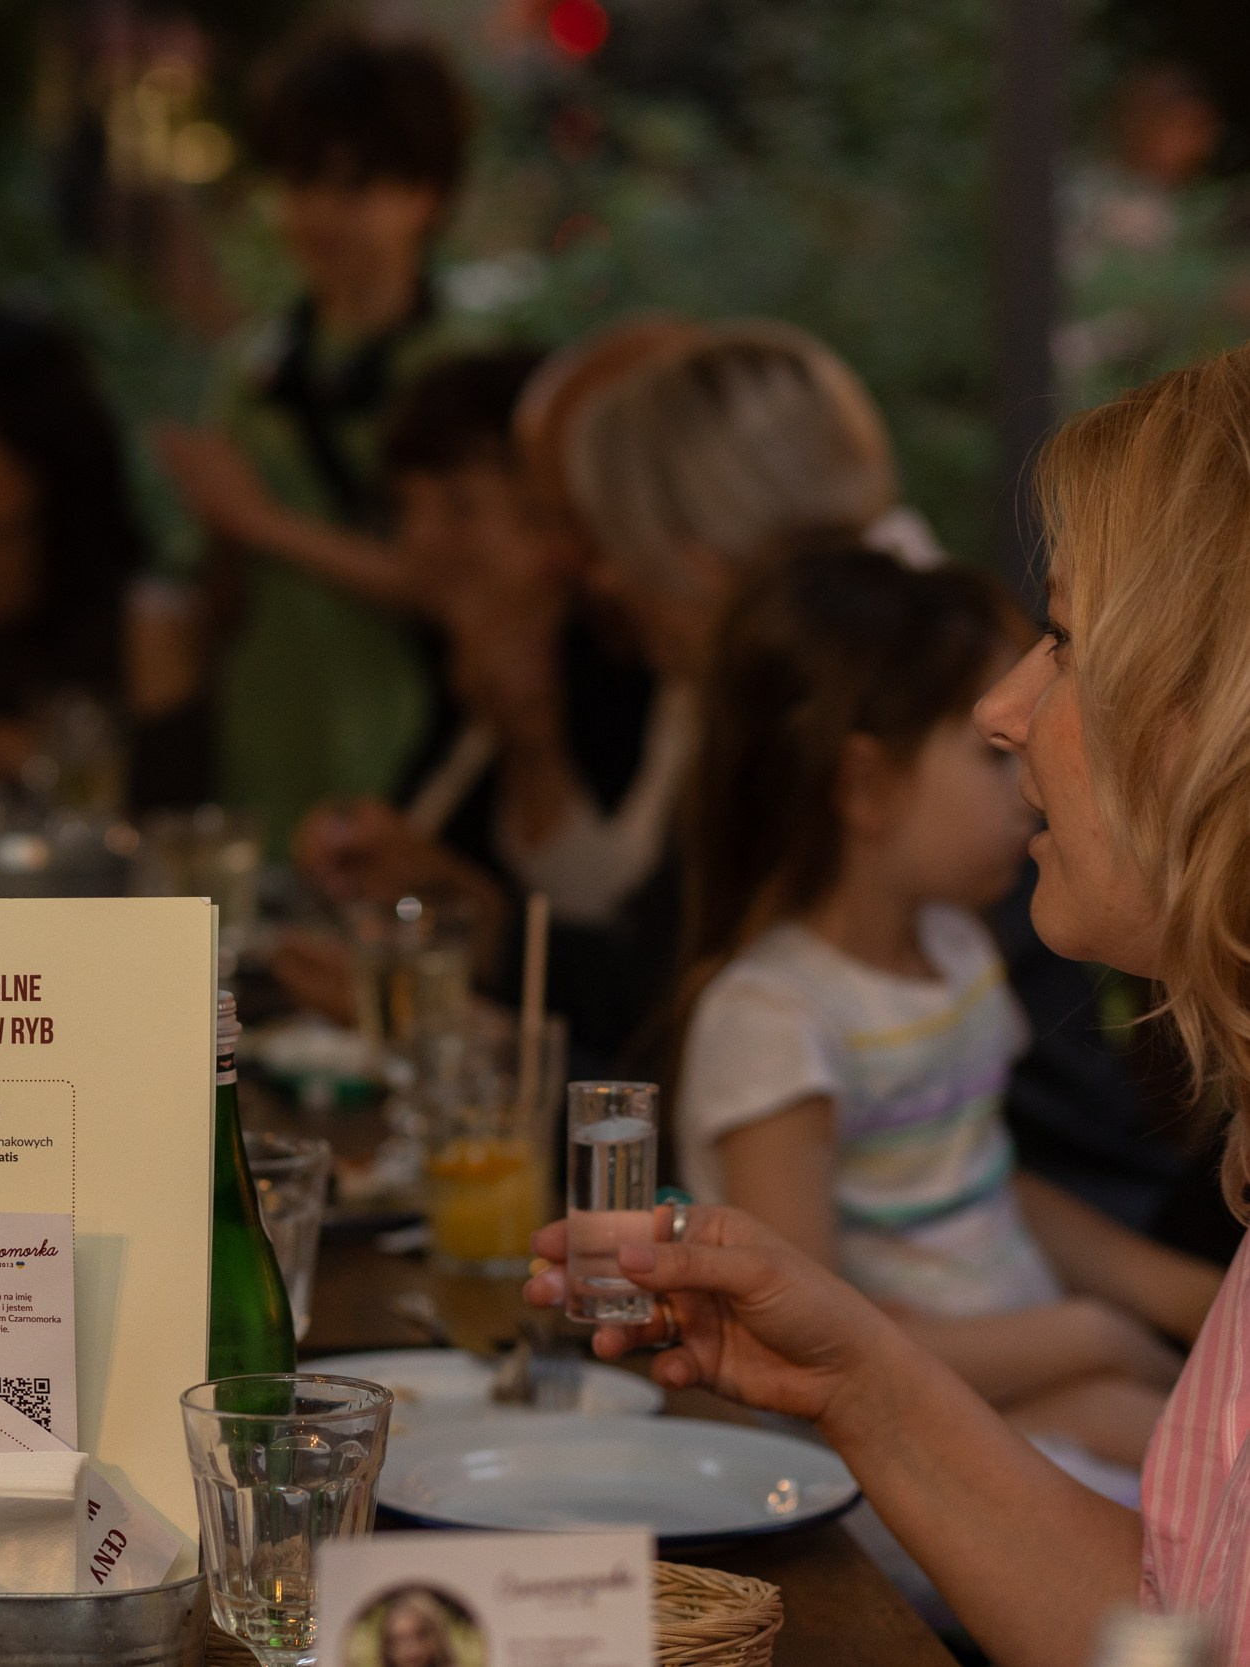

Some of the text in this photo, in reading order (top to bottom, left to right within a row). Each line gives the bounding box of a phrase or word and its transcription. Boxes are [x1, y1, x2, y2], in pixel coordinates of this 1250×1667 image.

[10, 1017, 55, 1045] RYB
[3, 1293, 14, 1301] na
[15, 1292, 33, 1302] imię
[5, 1304, 34, 1313] jestem
[8, 1314, 62, 1324] Czarnomorka
[90, 1529, 127, 1585] CENY
